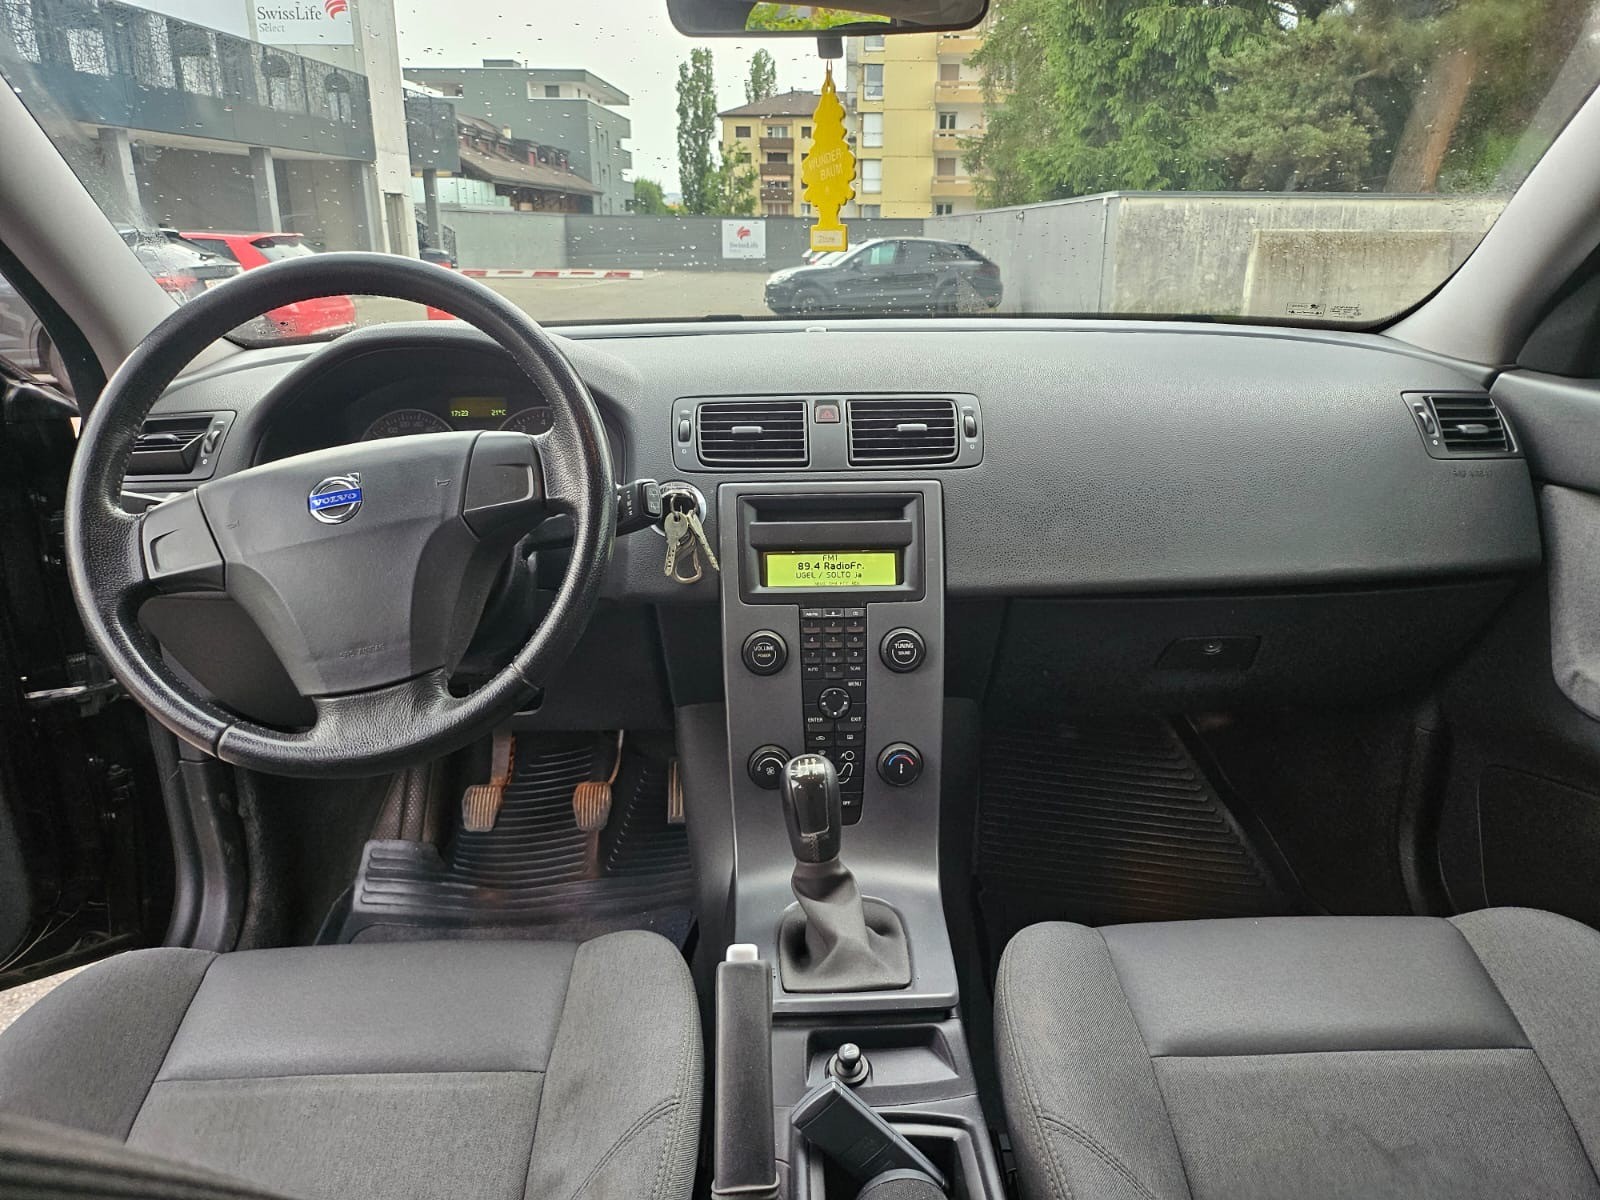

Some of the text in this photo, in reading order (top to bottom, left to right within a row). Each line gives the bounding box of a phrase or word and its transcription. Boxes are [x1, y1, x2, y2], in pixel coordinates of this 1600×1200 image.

[257, 6, 321, 20] SwissLife
[258, 23, 285, 32] Select
[820, 163, 843, 181] BAUM
[311, 492, 357, 506] VOLVO
[797, 561, 865, 570] 89.4 RadioFr.
